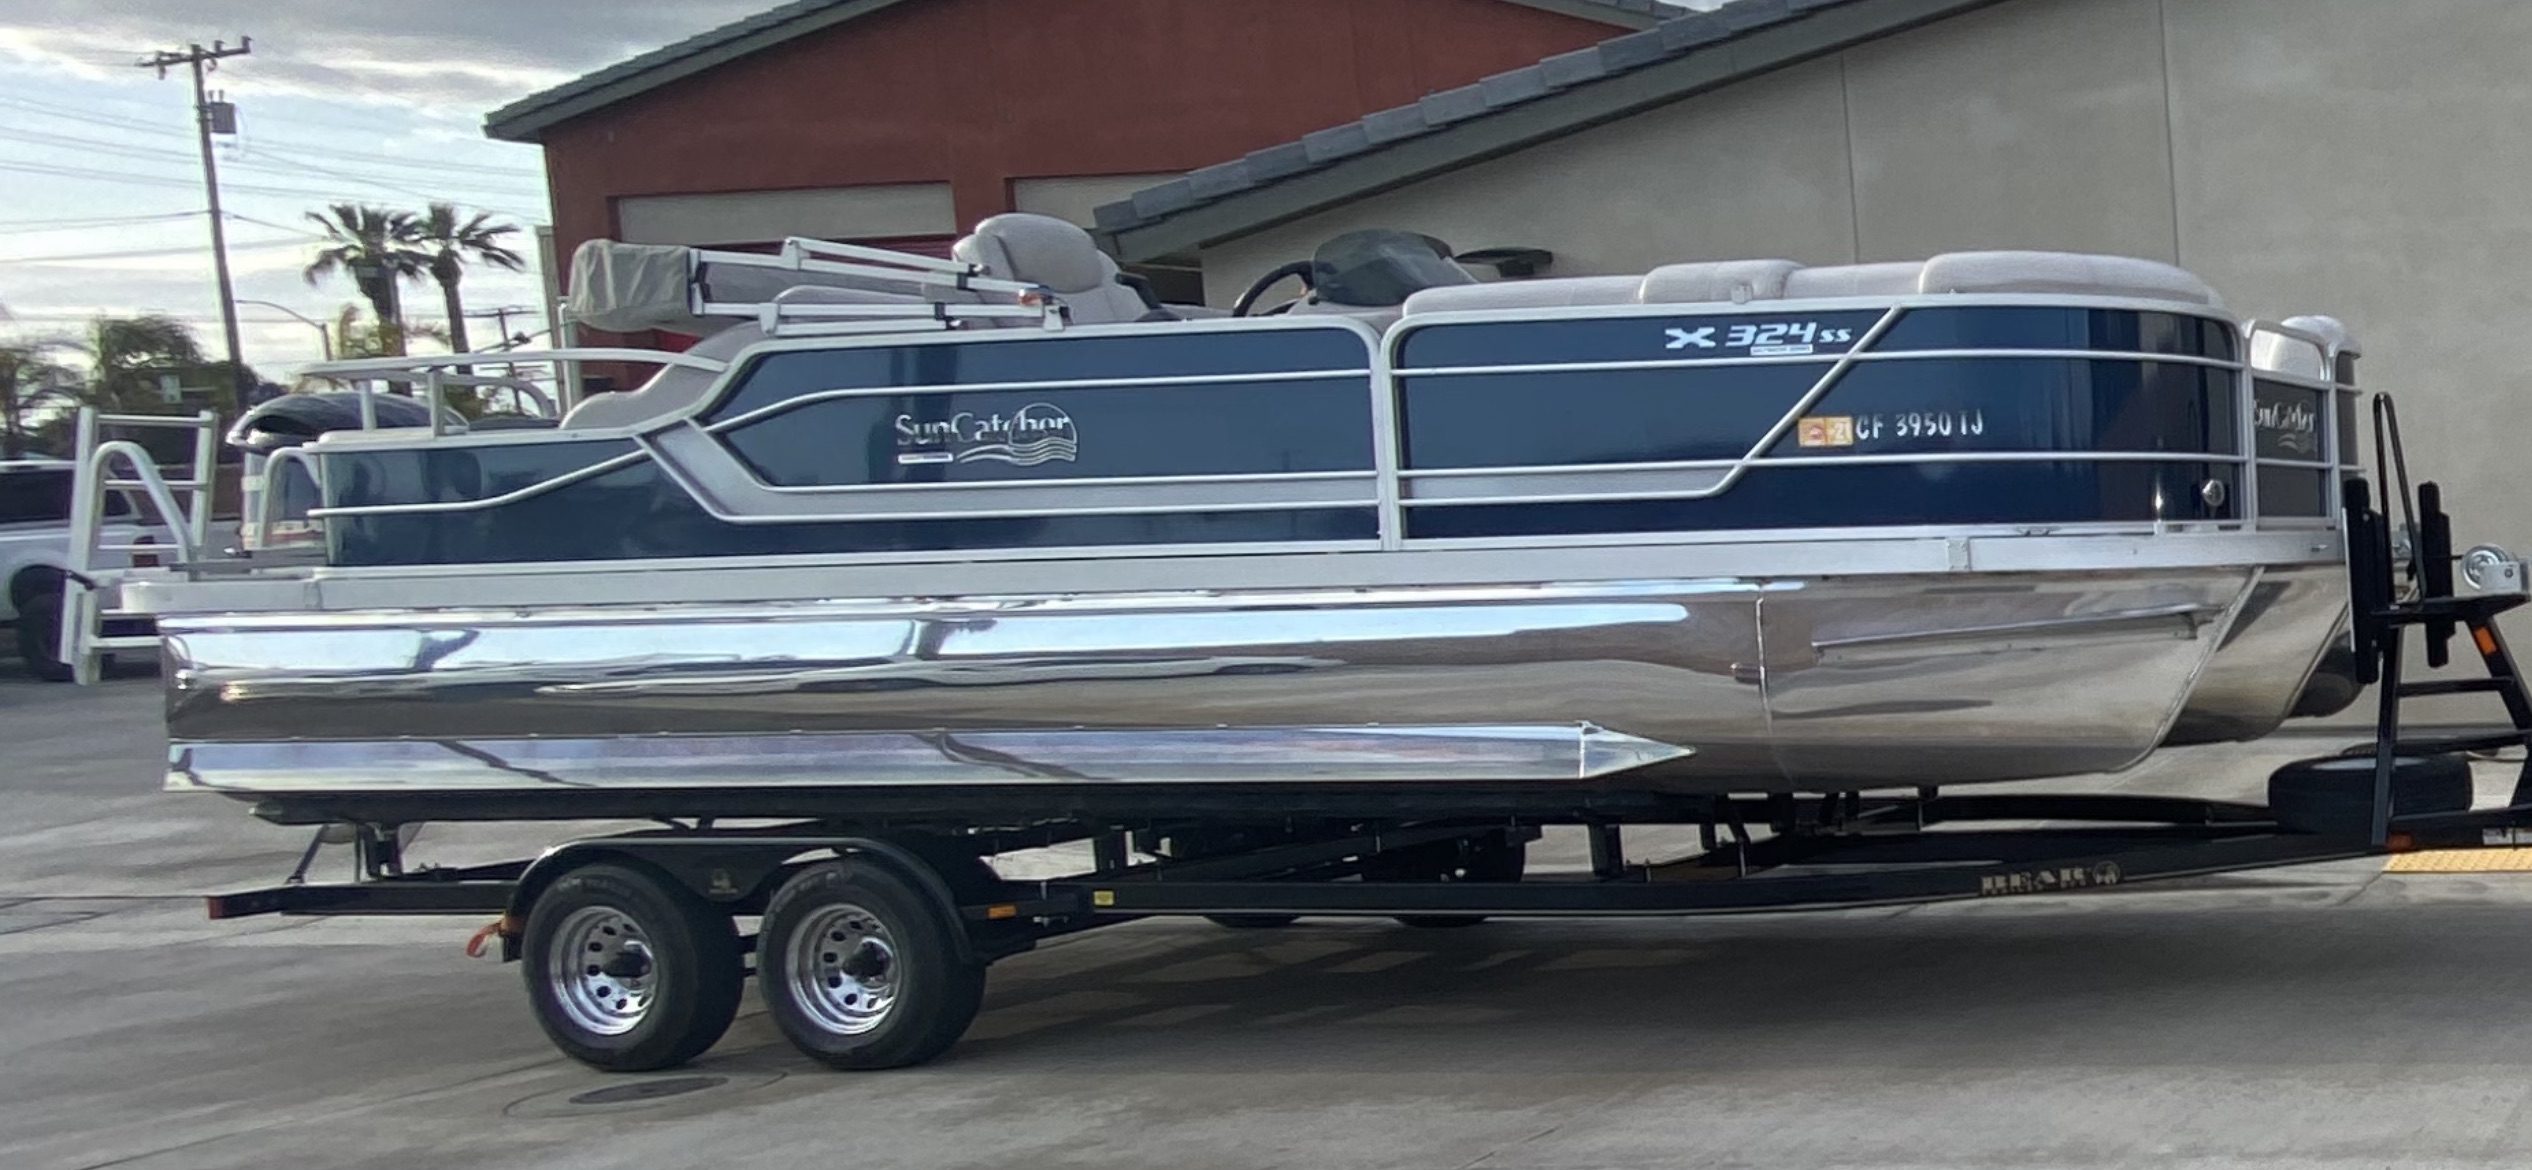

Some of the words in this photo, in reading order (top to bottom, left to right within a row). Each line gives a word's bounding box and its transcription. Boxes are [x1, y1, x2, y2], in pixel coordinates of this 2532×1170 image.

[1664, 327, 1716, 349] X
[1725, 322, 1817, 346] 324
[1856, 413, 1884, 440] CF
[1895, 411, 1952, 437] 3950
